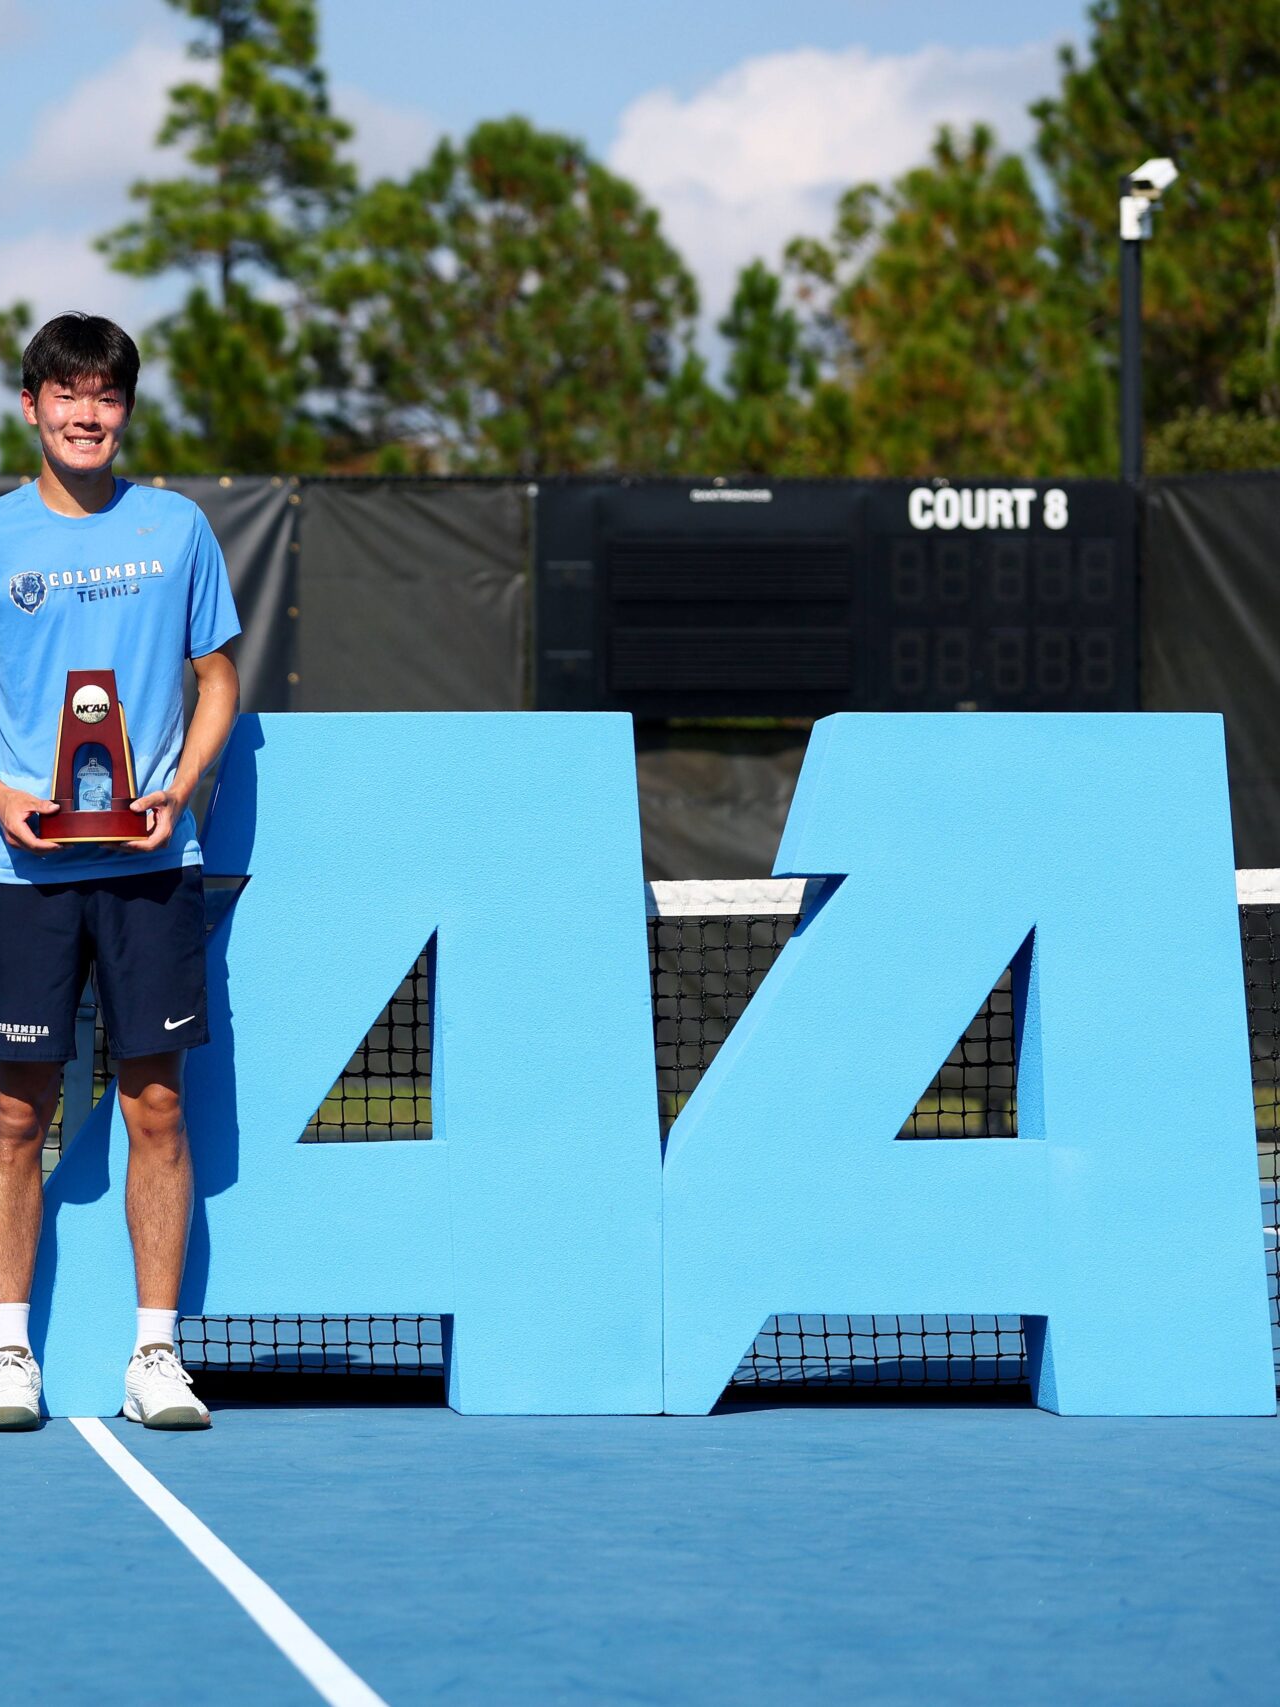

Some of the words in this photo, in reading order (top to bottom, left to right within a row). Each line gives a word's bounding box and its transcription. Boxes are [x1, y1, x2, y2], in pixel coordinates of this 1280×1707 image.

[908, 487, 1037, 530] COURT
[1043, 488, 1069, 530] 8
[49, 560, 163, 586] COLUMBIA
[77, 583, 140, 602] TENNIS
[76, 703, 108, 714] NCAA
[6, 1034, 36, 1043] TENNIS
